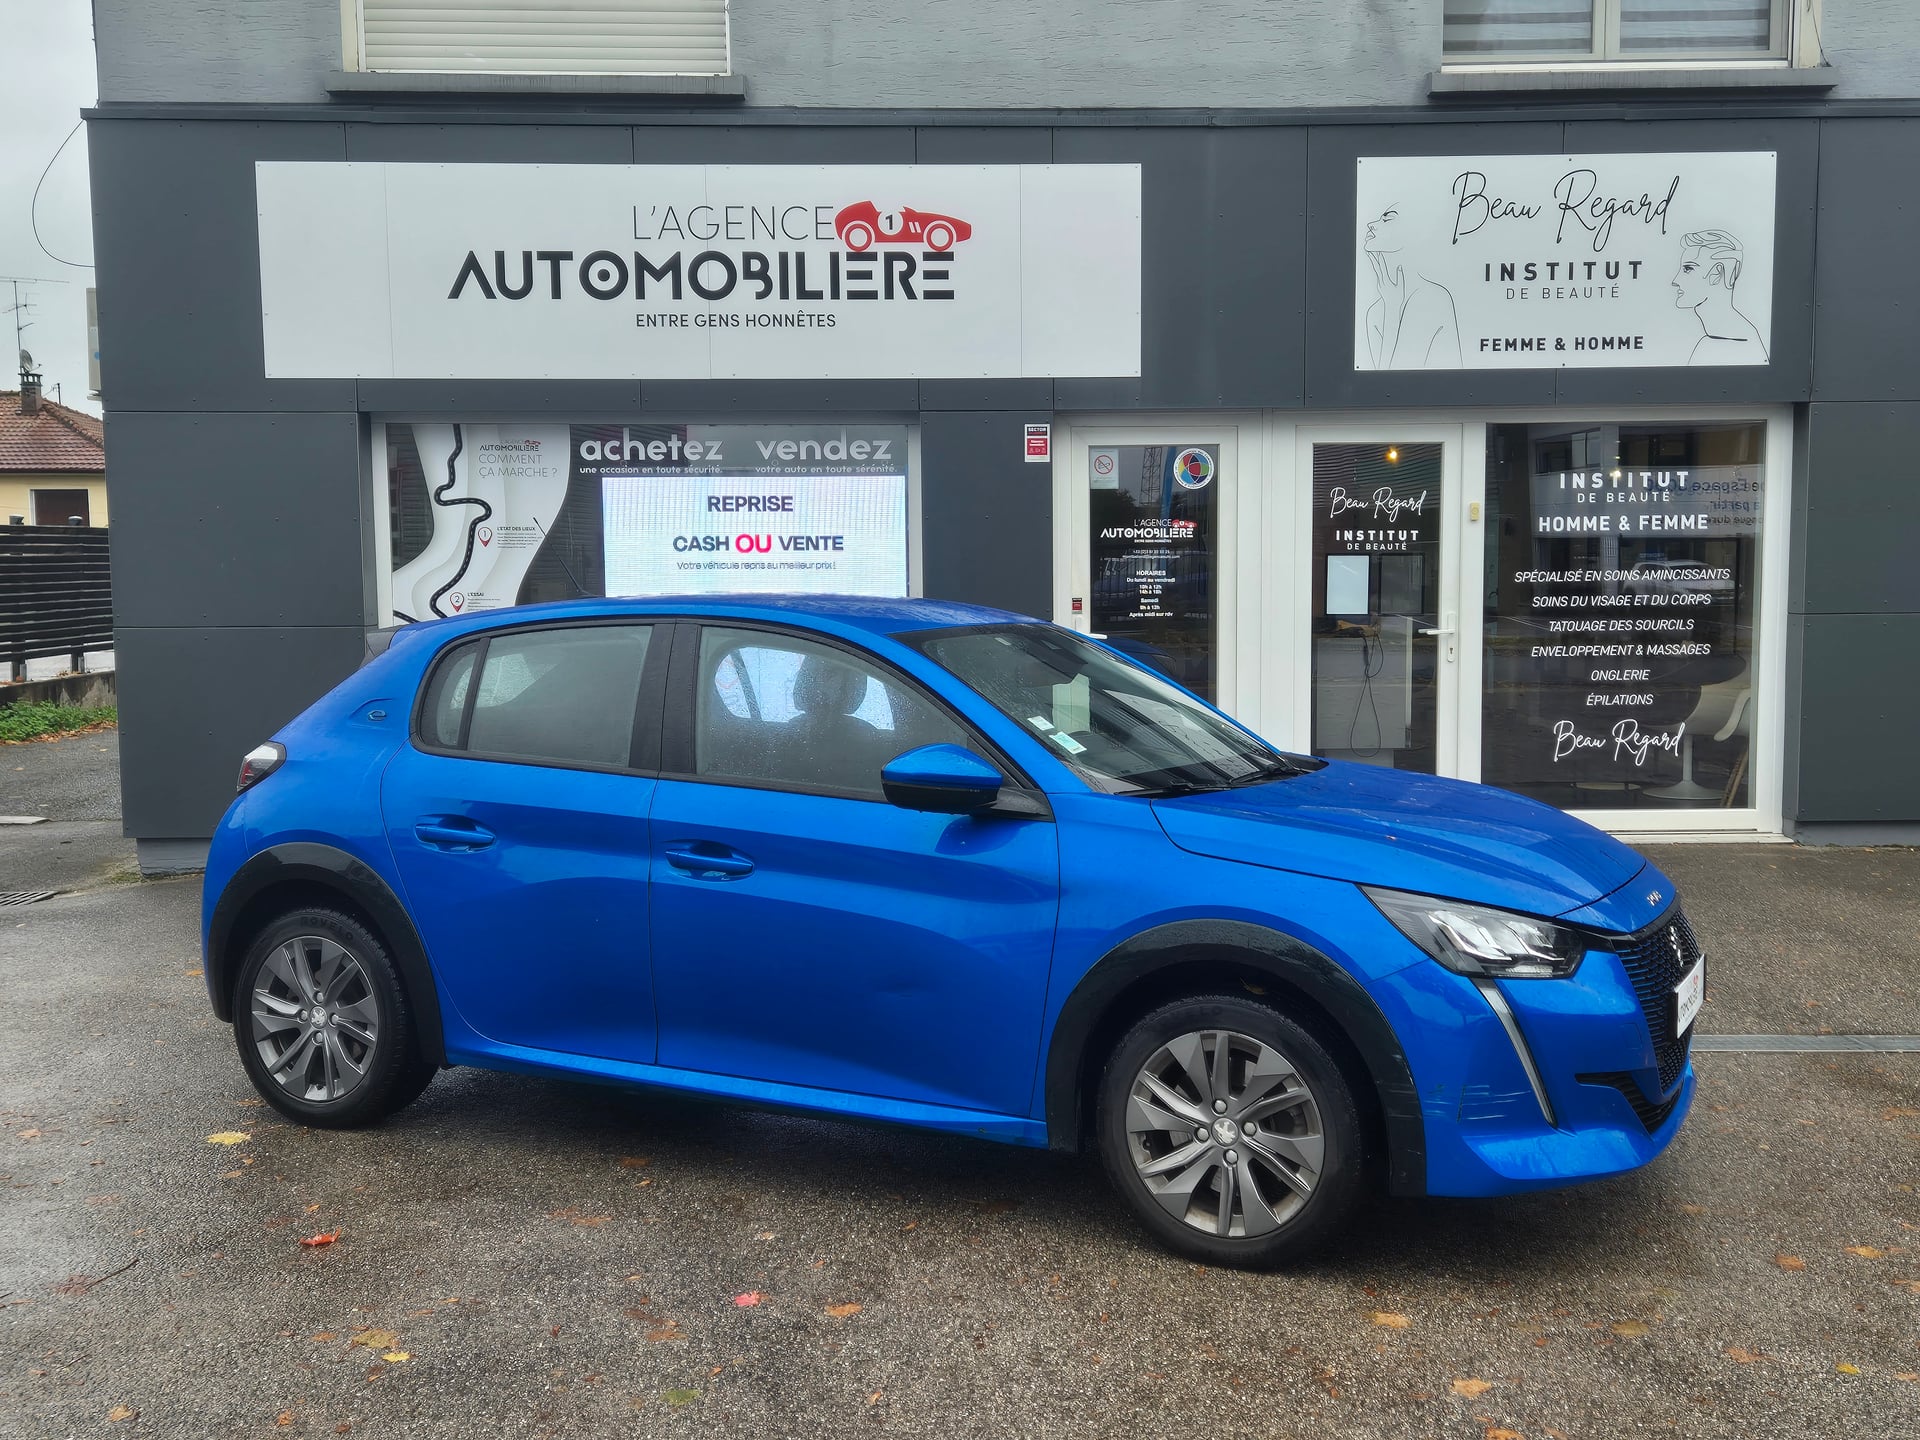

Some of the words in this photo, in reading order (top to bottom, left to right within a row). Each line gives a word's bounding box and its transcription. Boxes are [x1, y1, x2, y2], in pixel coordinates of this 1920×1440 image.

[1452, 171, 1541, 245] Beau
[1554, 170, 1680, 252] Regard
[633, 205, 836, 241] L'AGENCE
[1485, 261, 1643, 282] INSTITUT
[1506, 287, 1529, 300] DE
[1542, 283, 1620, 300] BEAUTÉ
[636, 314, 689, 328] ENTRE
[694, 313, 740, 327] GENS
[746, 309, 836, 328] HONNÊTES
[1480, 337, 1546, 352] FEMME
[1555, 337, 1566, 352] &
[1574, 336, 1644, 351] HOMME
[580, 427, 723, 461] achetez
[755, 427, 892, 461] vendez
[479, 454, 542, 465] COMMENT
[479, 466, 495, 478] ÇA
[498, 467, 548, 478] MARCHE
[552, 467, 558, 478] ?
[580, 466, 597, 474] une
[600, 464, 639, 474] occasion
[641, 466, 651, 474] en
[655, 465, 681, 474] toute
[755, 465, 781, 473] votre
[826, 465, 852, 473] toute
[1560, 471, 1689, 489] INSTITUT
[707, 495, 793, 512] REPRISE
[1577, 492, 1596, 503] DE
[1606, 489, 1670, 503] BEAUTÉ
[1330, 487, 1369, 519] Beau
[1373, 486, 1427, 523] Regard
[1538, 515, 1610, 532] HOMME
[1619, 515, 1630, 531] &
[1639, 514, 1708, 531] FEMME
[673, 535, 730, 552] CASH
[735, 533, 772, 553] OU
[778, 535, 844, 551] VENTE
[1336, 530, 1419, 541] INSTITUT
[1365, 541, 1407, 550] BEAUTÉ
[677, 561, 701, 570] Votre
[702, 560, 739, 570] véhicule
[740, 561, 765, 572] repris
[767, 562, 779, 570] au
[779, 561, 815, 570] meilleur
[815, 561, 832, 572] prix
[1514, 569, 1583, 583] SPÉCIALISÉ
[1585, 570, 1601, 582] EN
[1603, 569, 1640, 582] SOINS
[1642, 568, 1731, 581] AMINCISSANTS
[1532, 596, 1568, 608] SOINS
[1570, 596, 1588, 607] DU
[1590, 595, 1631, 607] VISAGE
[1633, 595, 1649, 606] ET
[1651, 595, 1668, 606] DU
[1671, 594, 1711, 606] CORPS
[1549, 620, 1606, 632] TATOUAGE
[1609, 620, 1633, 631] DES
[1635, 619, 1694, 631] SOURCILS
[1531, 645, 1634, 657] ENVELOPPEMENT
[1636, 645, 1644, 656] &
[1646, 644, 1711, 656] MASSAGES
[1591, 669, 1650, 681] ONGLERIE
[1586, 692, 1654, 706] ÉPILATIONS
[1553, 720, 1606, 763] Beau
[1612, 719, 1686, 767] Regard
